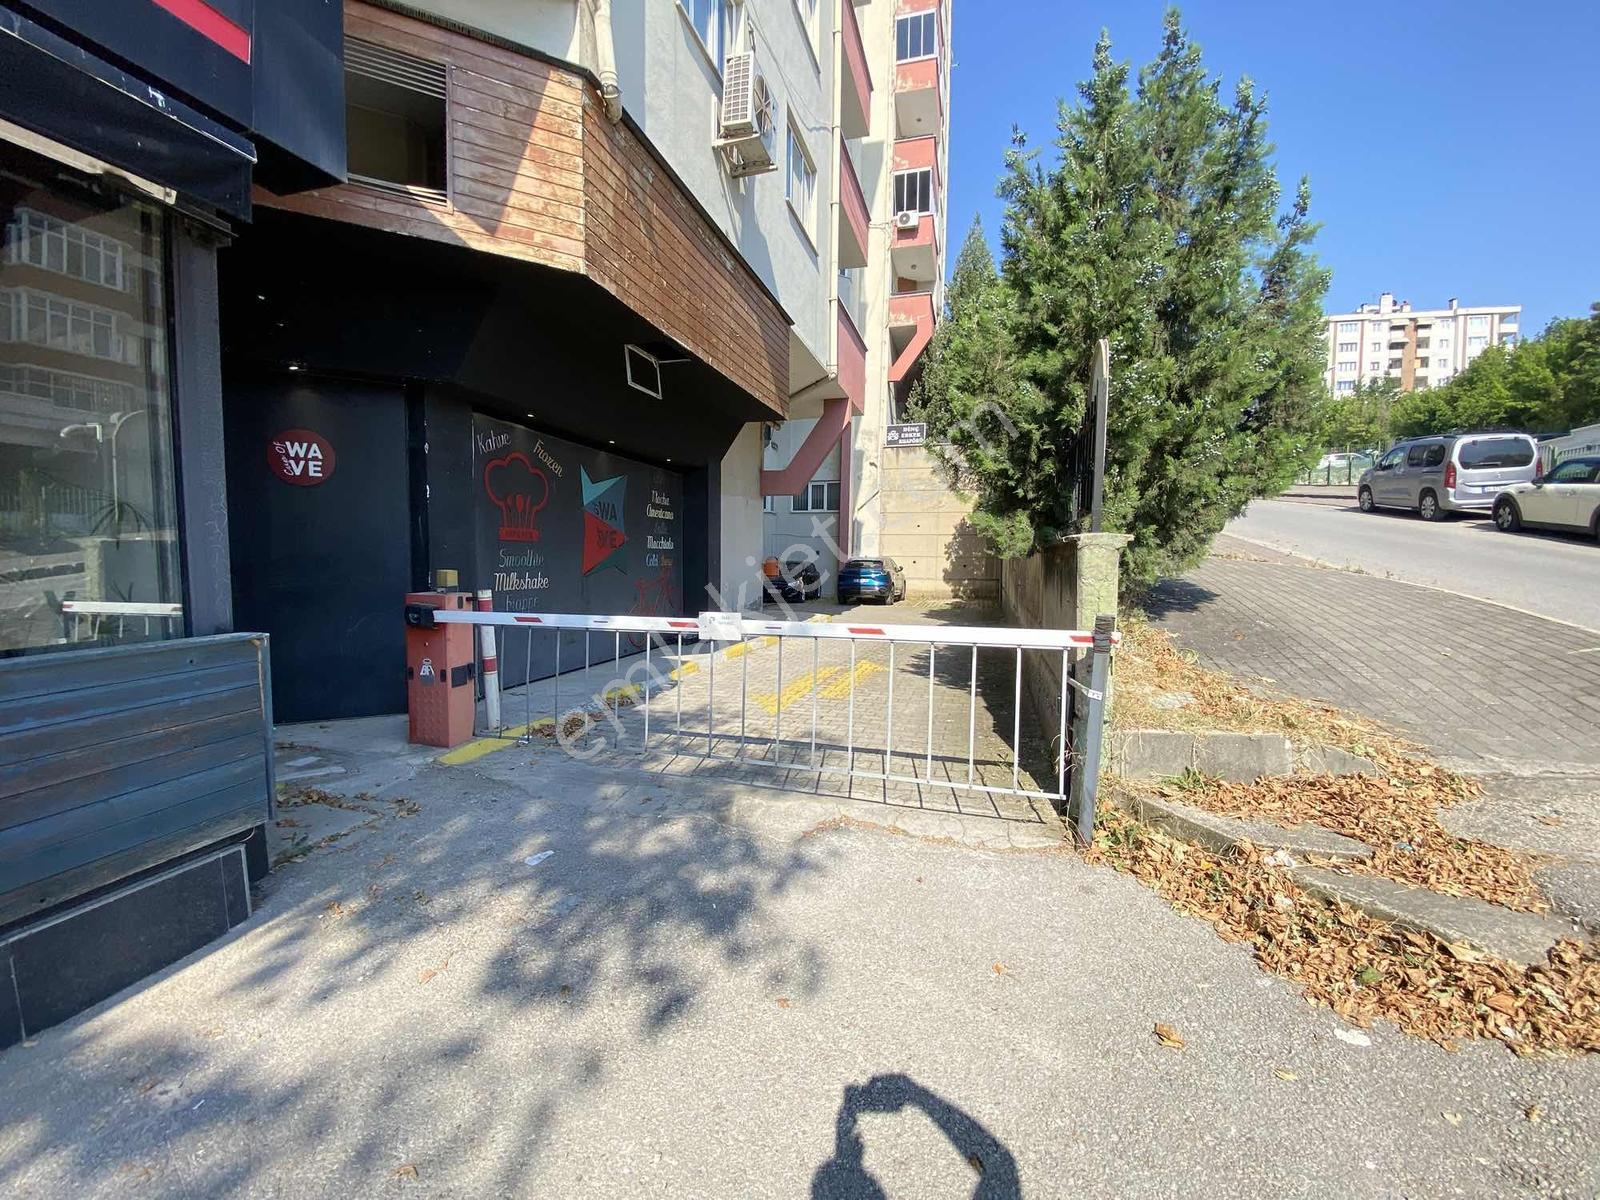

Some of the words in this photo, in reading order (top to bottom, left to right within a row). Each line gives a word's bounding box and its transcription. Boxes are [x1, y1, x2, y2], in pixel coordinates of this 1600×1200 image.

[285, 441, 323, 459] WA
[477, 430, 511, 454] Kahve
[288, 459, 323, 477] VE
[498, 548, 545, 568] Smoothie
[493, 571, 550, 592] Milkshake
